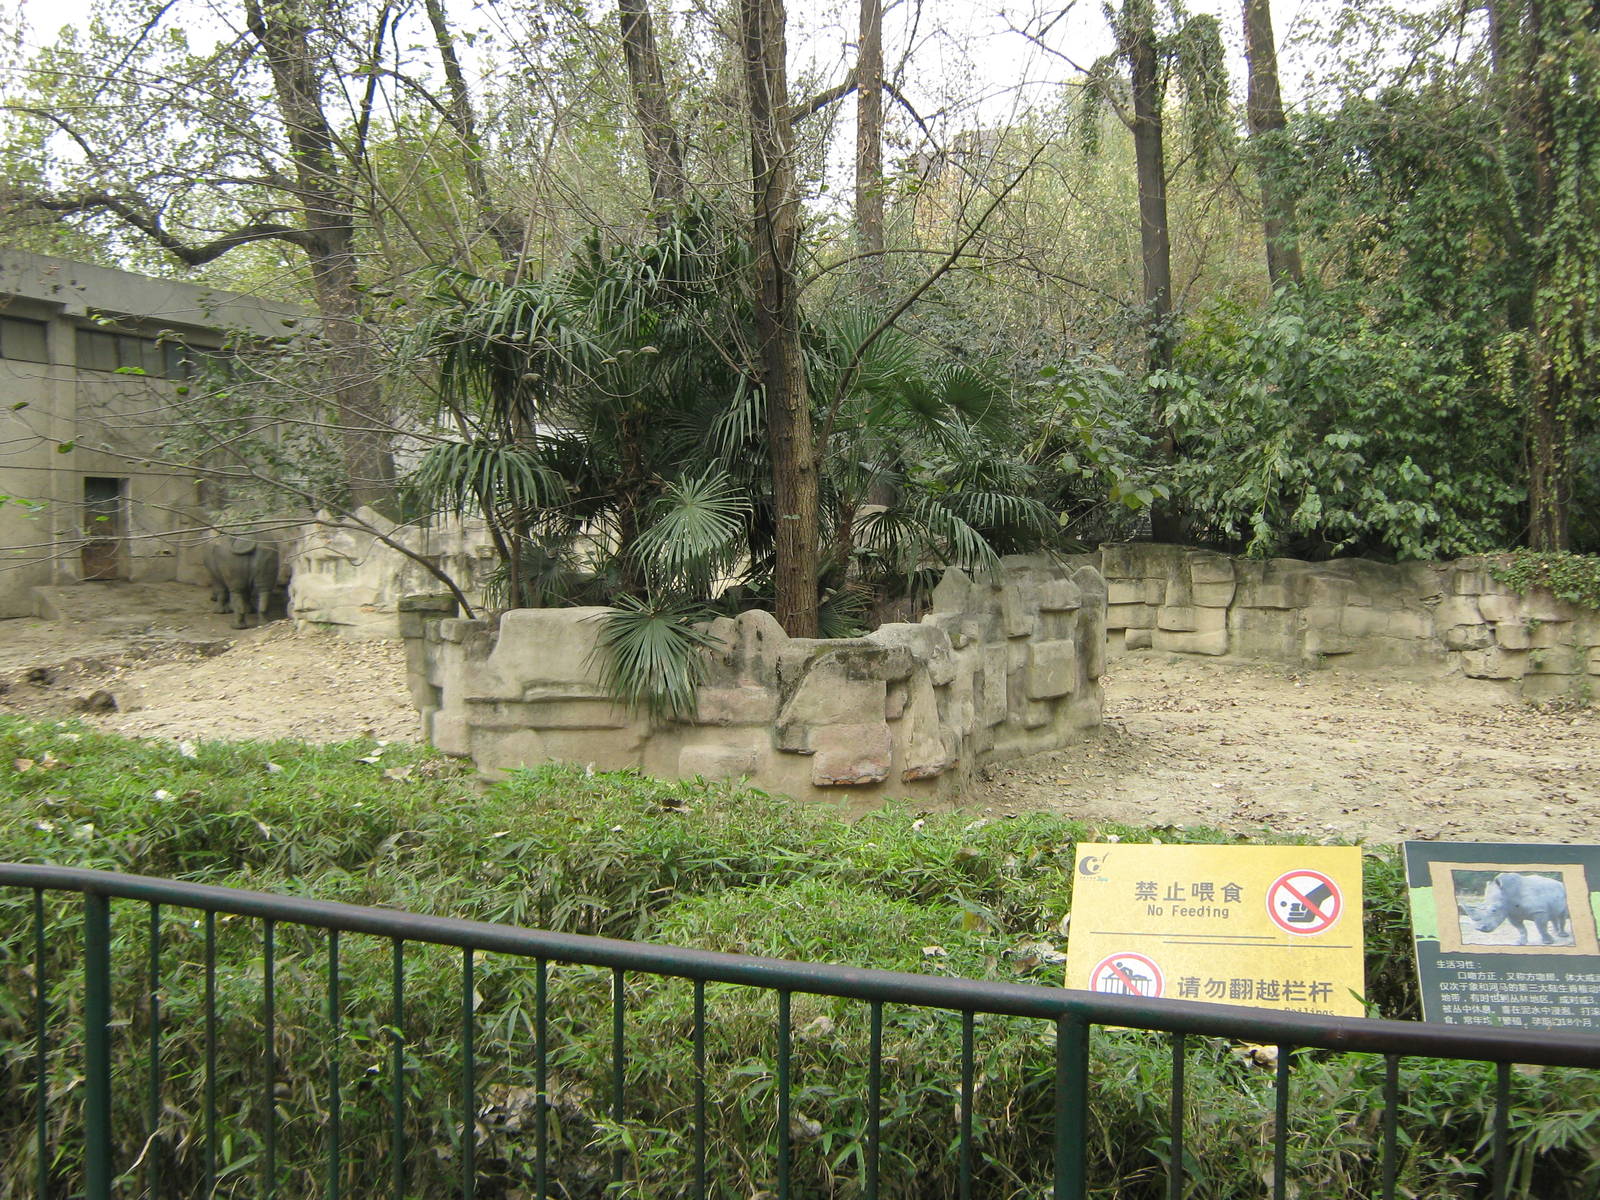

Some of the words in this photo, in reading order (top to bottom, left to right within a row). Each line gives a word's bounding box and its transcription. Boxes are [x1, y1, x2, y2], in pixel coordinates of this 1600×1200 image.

[1135, 881, 1243, 903] 禁止喂食
[1147, 904, 1163, 916] No
[1172, 905, 1229, 919] Feeding
[1177, 976, 1333, 1003] 请勿翻越栏杆
